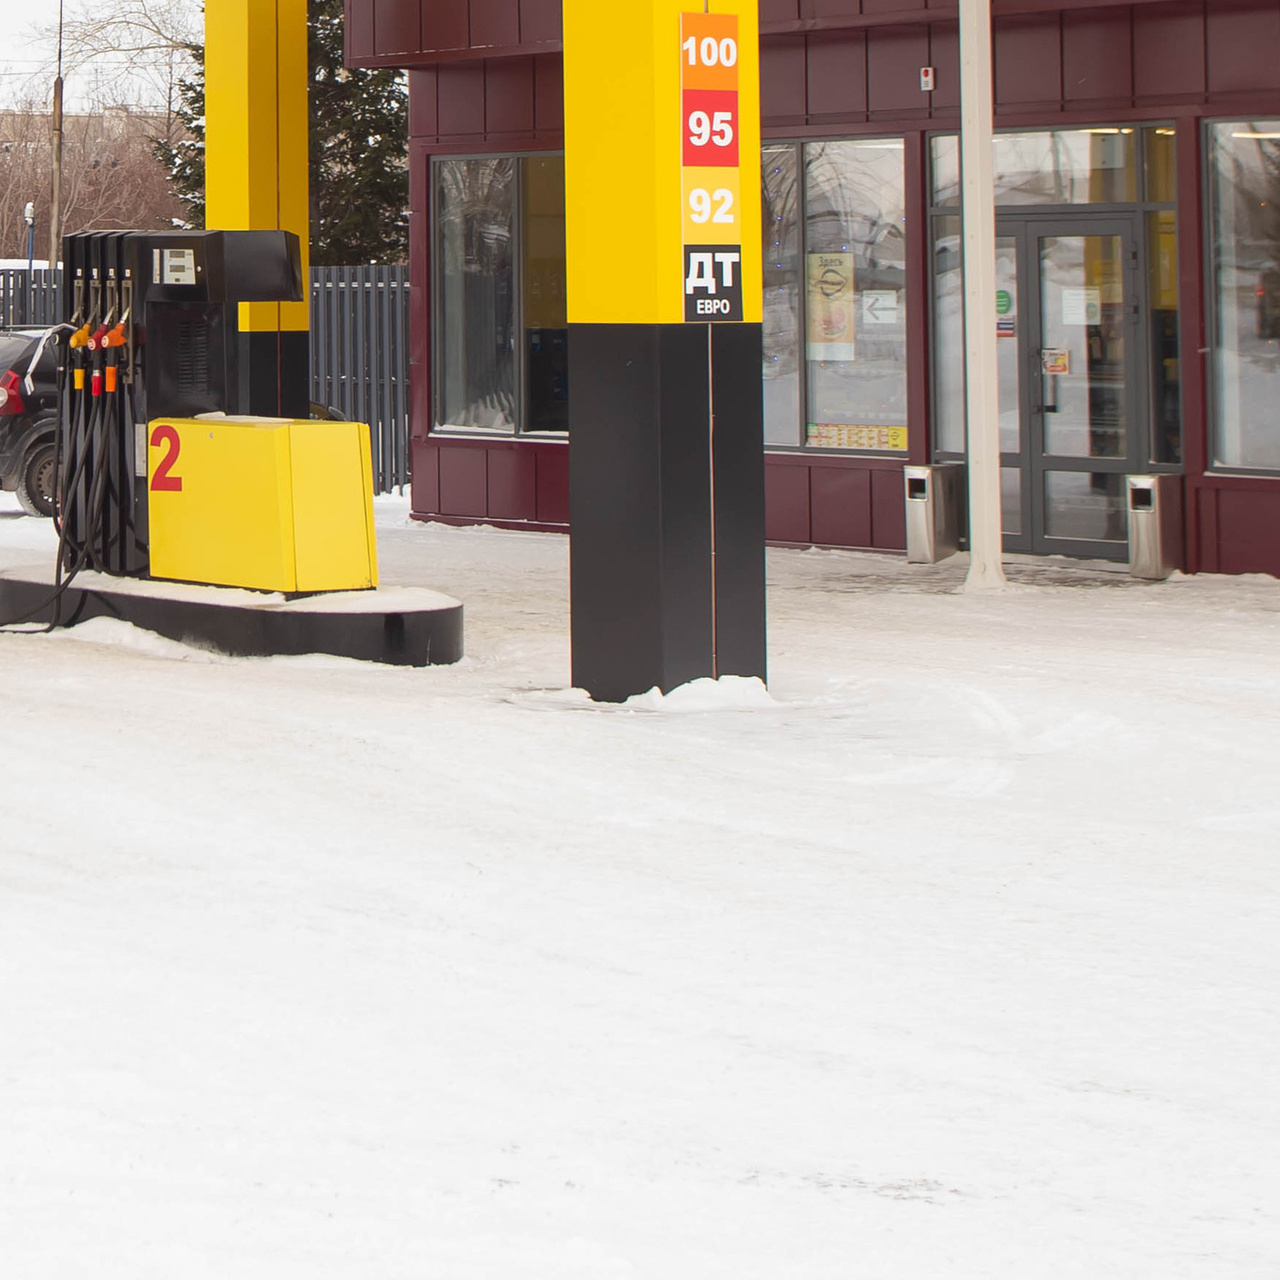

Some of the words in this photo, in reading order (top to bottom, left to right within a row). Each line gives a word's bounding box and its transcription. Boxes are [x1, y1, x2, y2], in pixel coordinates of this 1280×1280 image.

[682, 36, 737, 67] 100
[688, 111, 733, 147] 95
[689, 188, 734, 224] 92
[686, 252, 740, 295] ДТ
[696, 299, 730, 315] ЕВРО
[150, 425, 182, 491] 2
